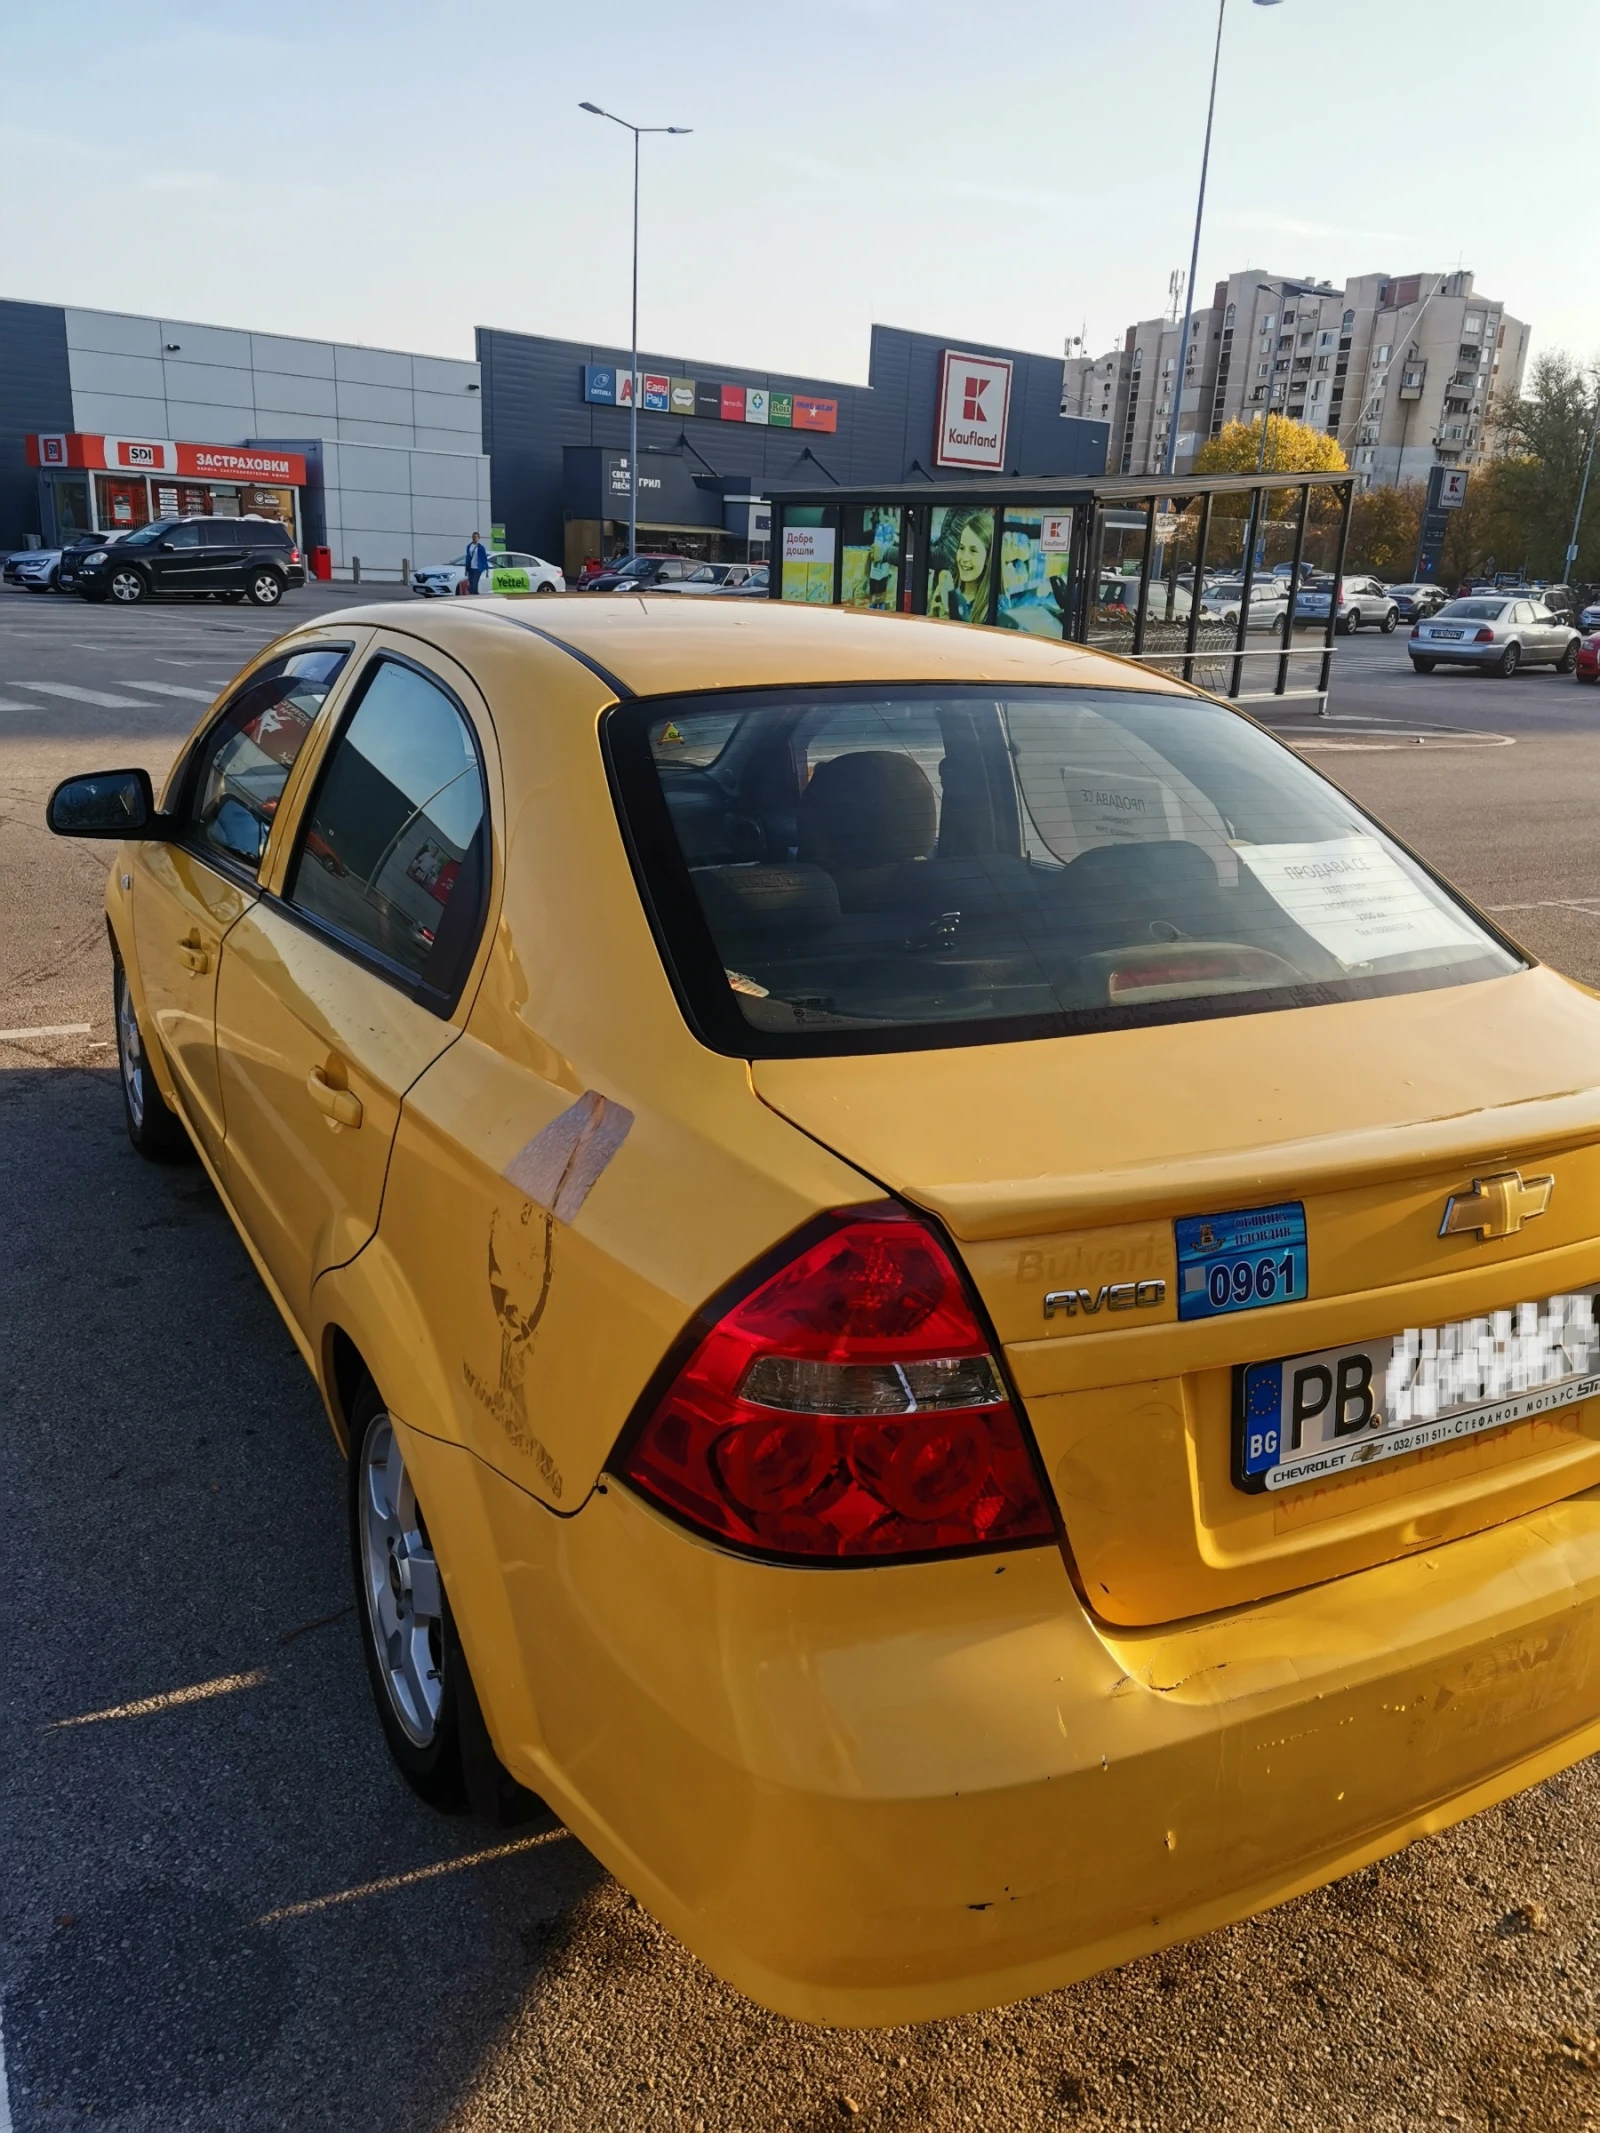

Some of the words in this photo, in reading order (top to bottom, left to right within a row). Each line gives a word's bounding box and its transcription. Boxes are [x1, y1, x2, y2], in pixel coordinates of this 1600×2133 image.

[646, 381, 668, 396] Easy
[646, 393, 663, 407] Pay
[949, 428, 997, 448] Kaufland
[131, 448, 152, 460] SDI
[196, 453, 290, 473] ЗАСТРАХОВКИ
[612, 471, 631, 479] СВЕЖ
[639, 478, 661, 488] ГРИЛ
[612, 482, 630, 490] ЛЕСН
[787, 533, 814, 546] Добре
[786, 547, 814, 556] дошли
[1284, 859, 1353, 880] ПРОДАВА
[1351, 857, 1372, 871] СЕ
[1234, 1211, 1288, 1229] ОБЩИНА
[1234, 1226, 1291, 1245] ПЛОВДИВ
[1208, 1252, 1295, 1308] 0961
[1043, 1279, 1166, 1321] AVEO
[1291, 1354, 1375, 1450] PB
[1249, 1429, 1278, 1460] BG
[1273, 1454, 1347, 1483] CHEVROLET
